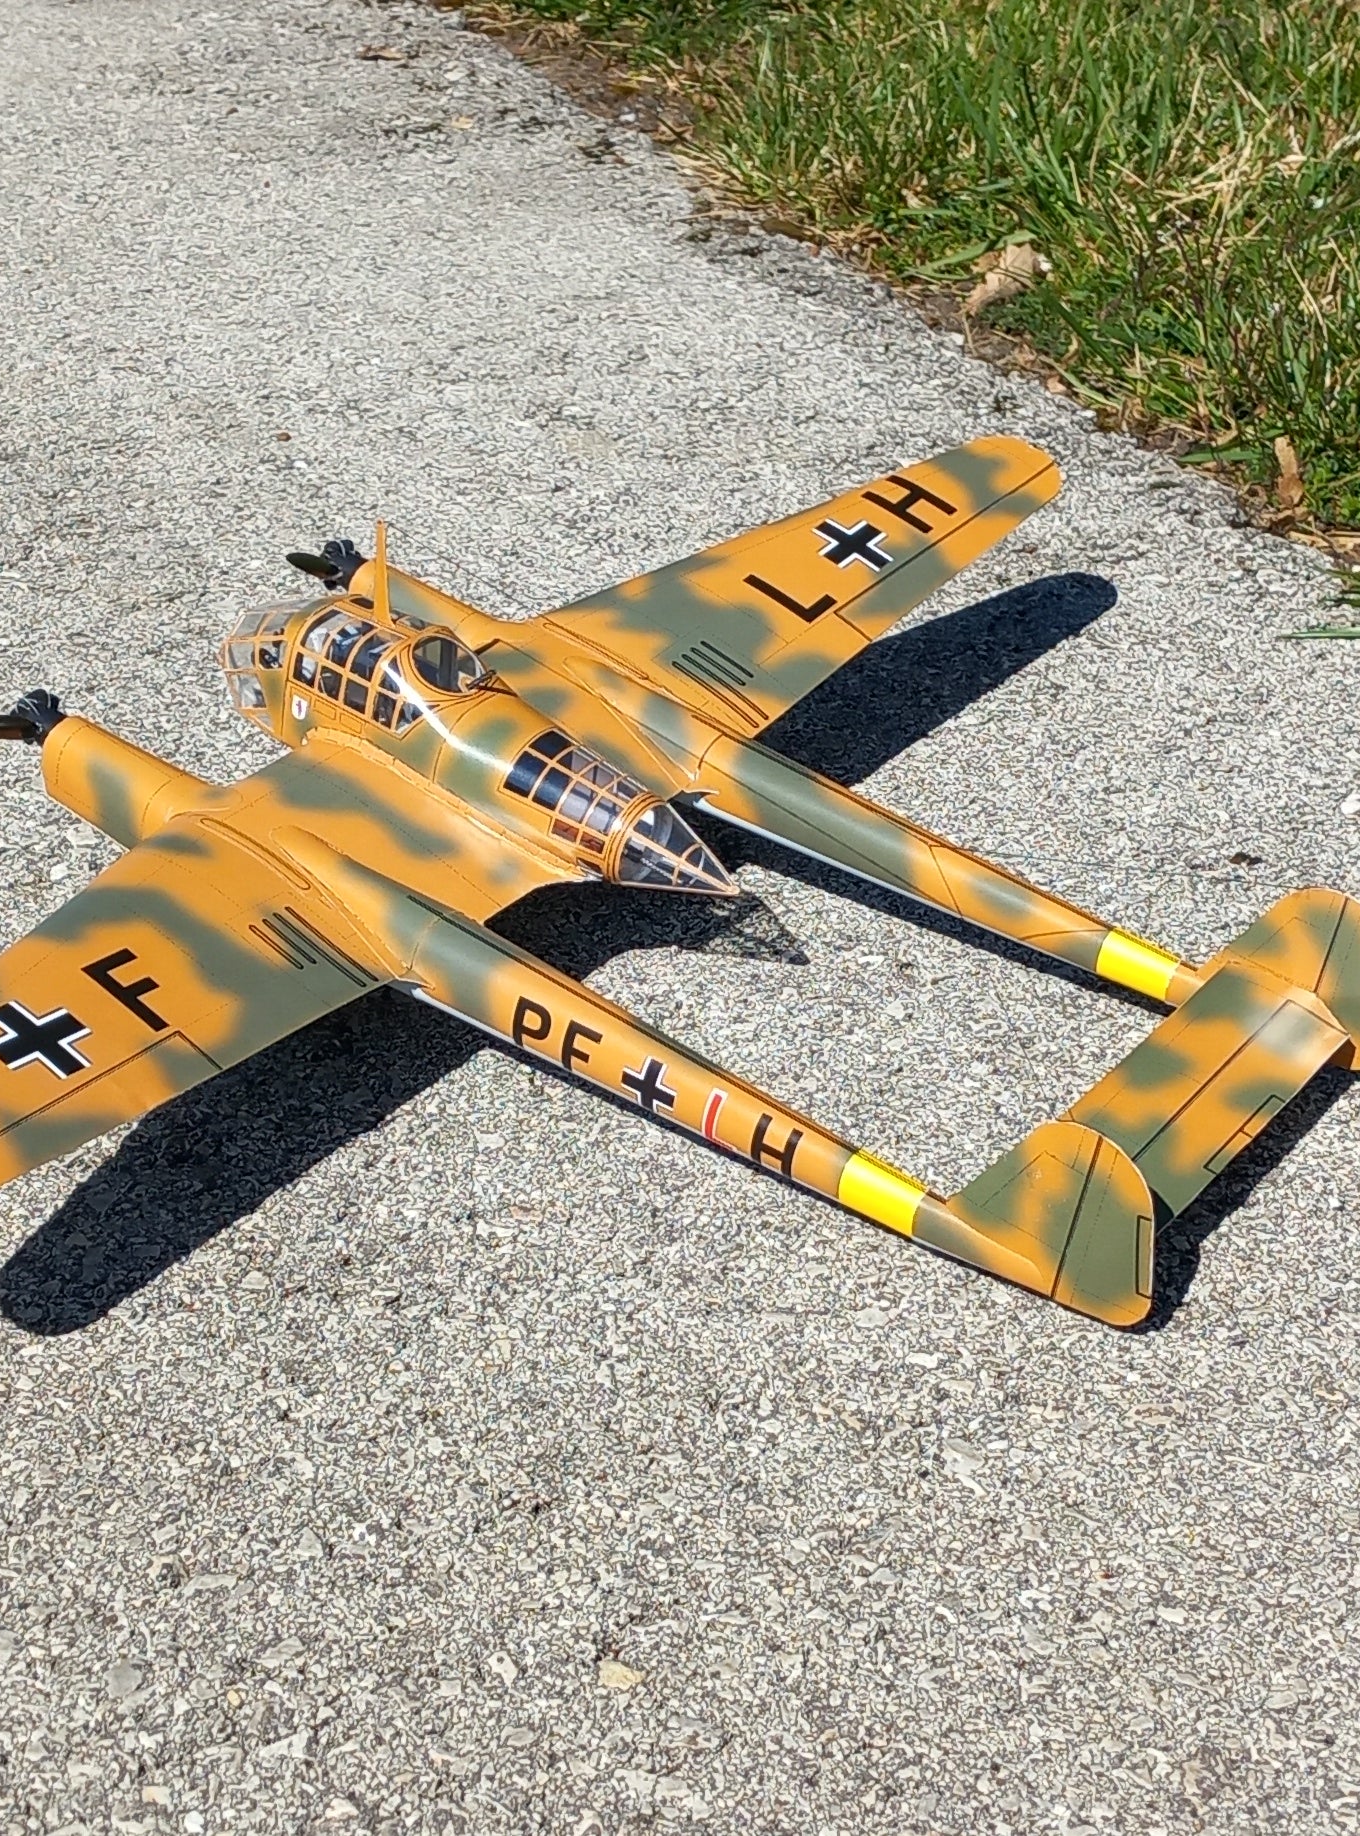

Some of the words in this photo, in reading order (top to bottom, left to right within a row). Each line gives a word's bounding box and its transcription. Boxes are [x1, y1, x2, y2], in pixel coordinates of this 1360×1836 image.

[743, 574, 838, 623] L
[861, 474, 958, 533] H
[81, 947, 170, 1032] F
[512, 996, 603, 1073] PF
